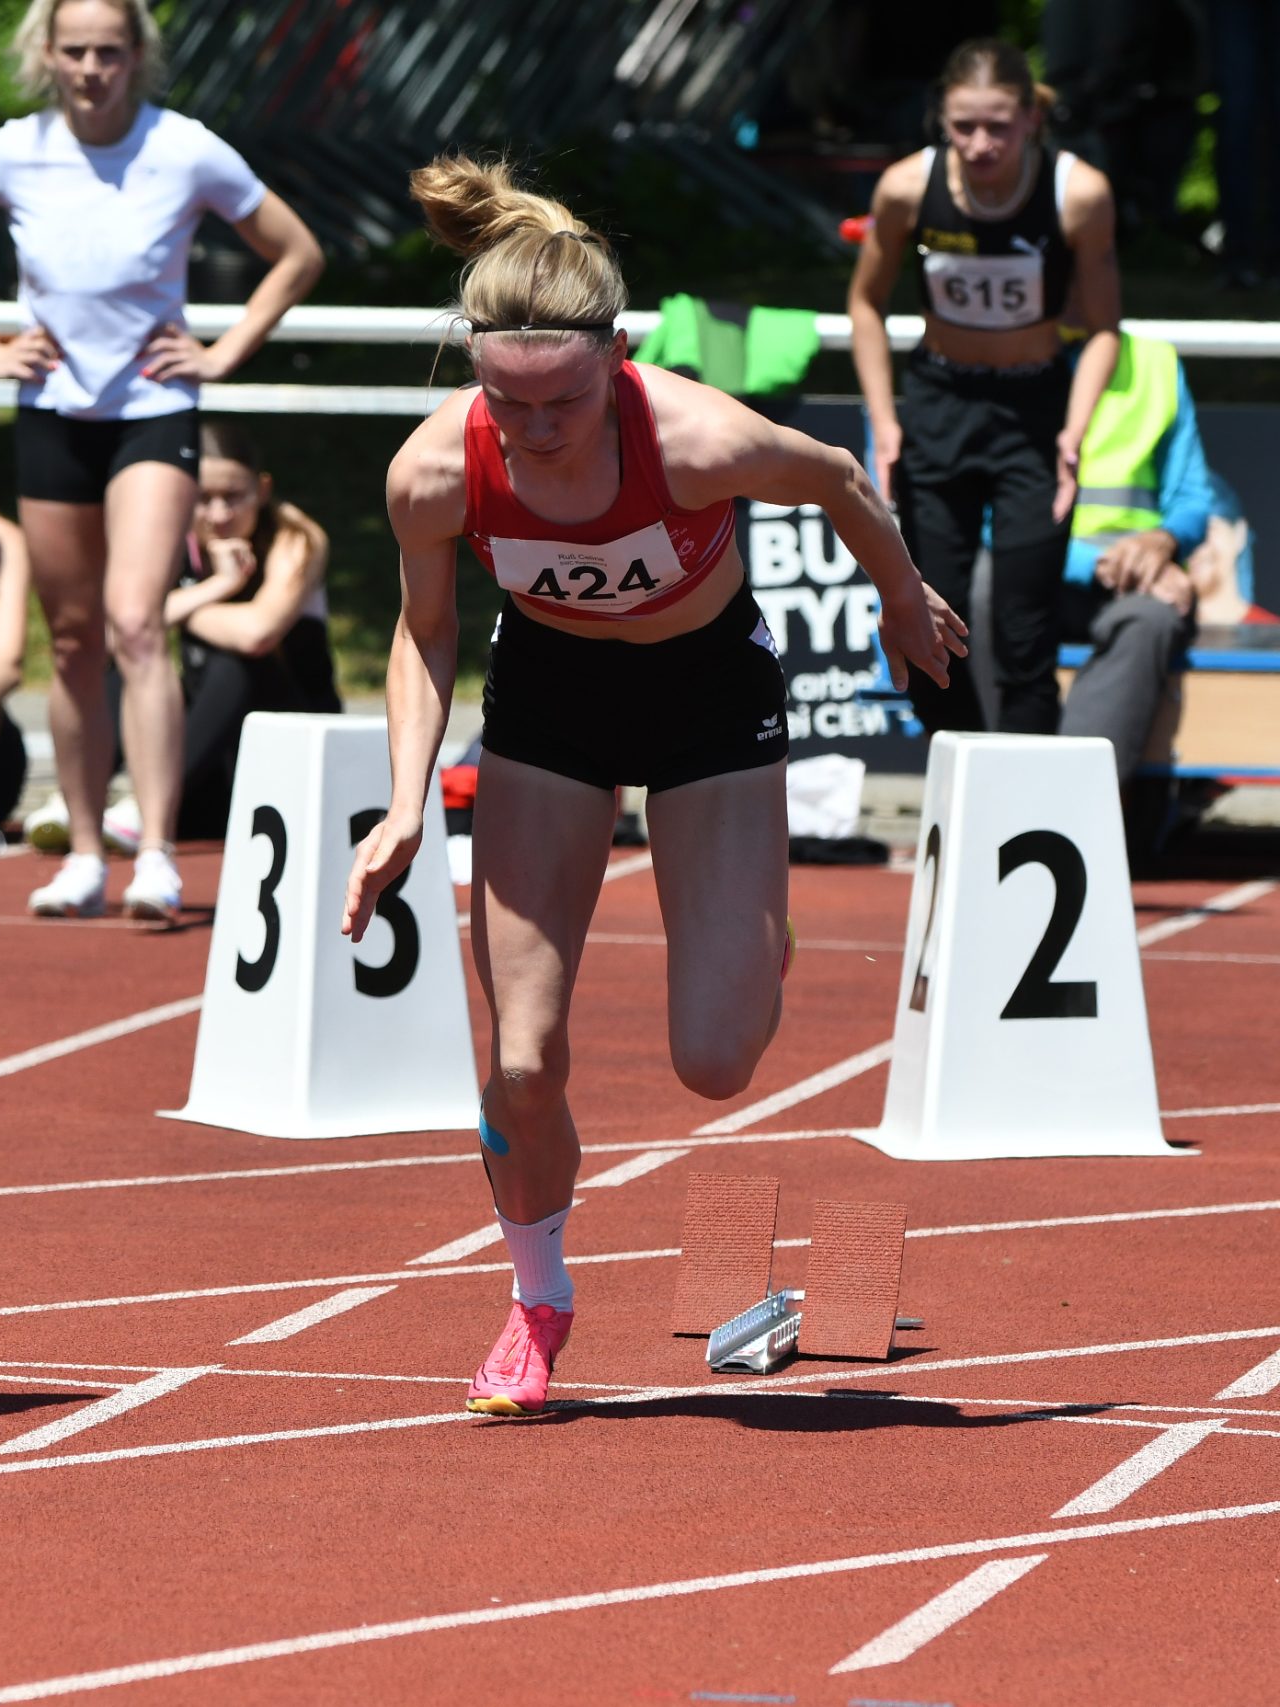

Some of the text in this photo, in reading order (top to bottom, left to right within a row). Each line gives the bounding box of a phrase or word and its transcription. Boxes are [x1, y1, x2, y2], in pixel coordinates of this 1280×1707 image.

[944, 277, 1025, 312] 615
[527, 558, 660, 600] 424
[750, 518, 859, 587] BU
[756, 726, 782, 741] erima
[235, 805, 287, 992] 3
[349, 808, 421, 998] 3
[909, 823, 941, 1013] 2
[999, 829, 1098, 1020] 2
